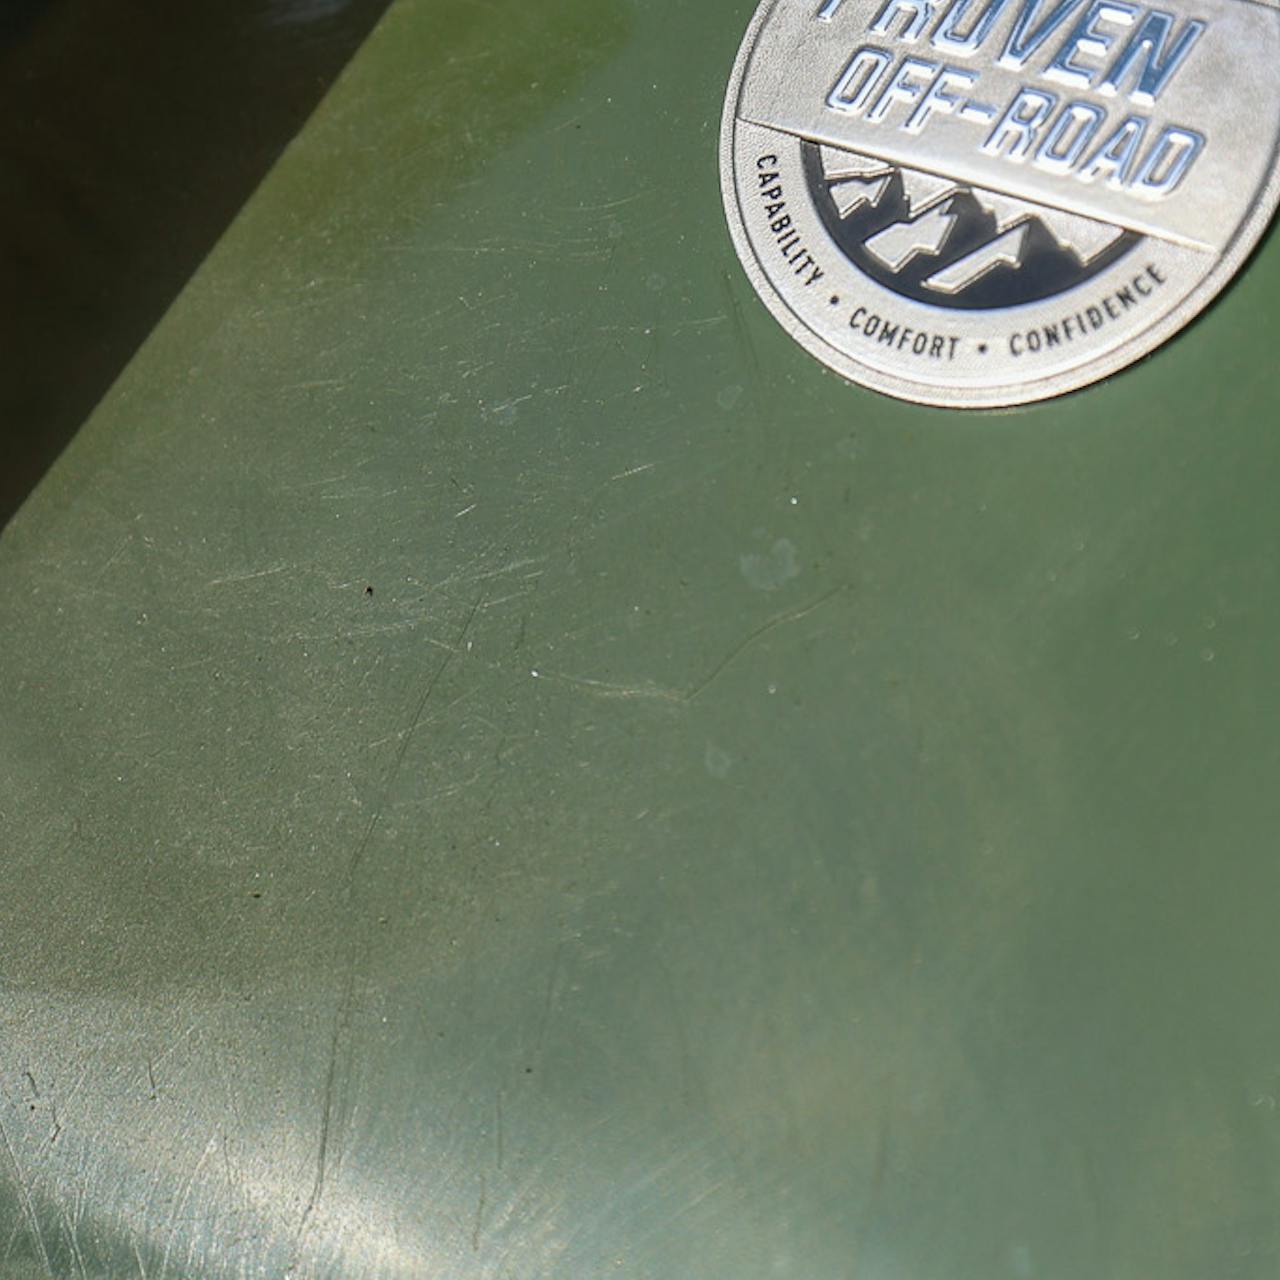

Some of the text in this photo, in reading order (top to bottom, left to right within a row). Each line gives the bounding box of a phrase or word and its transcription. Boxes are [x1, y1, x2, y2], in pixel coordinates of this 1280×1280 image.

[826, 45, 1206, 204] OFF-ROAD
[756, 153, 1167, 361] CAPABILITY COMFORT CONFIDENCE
